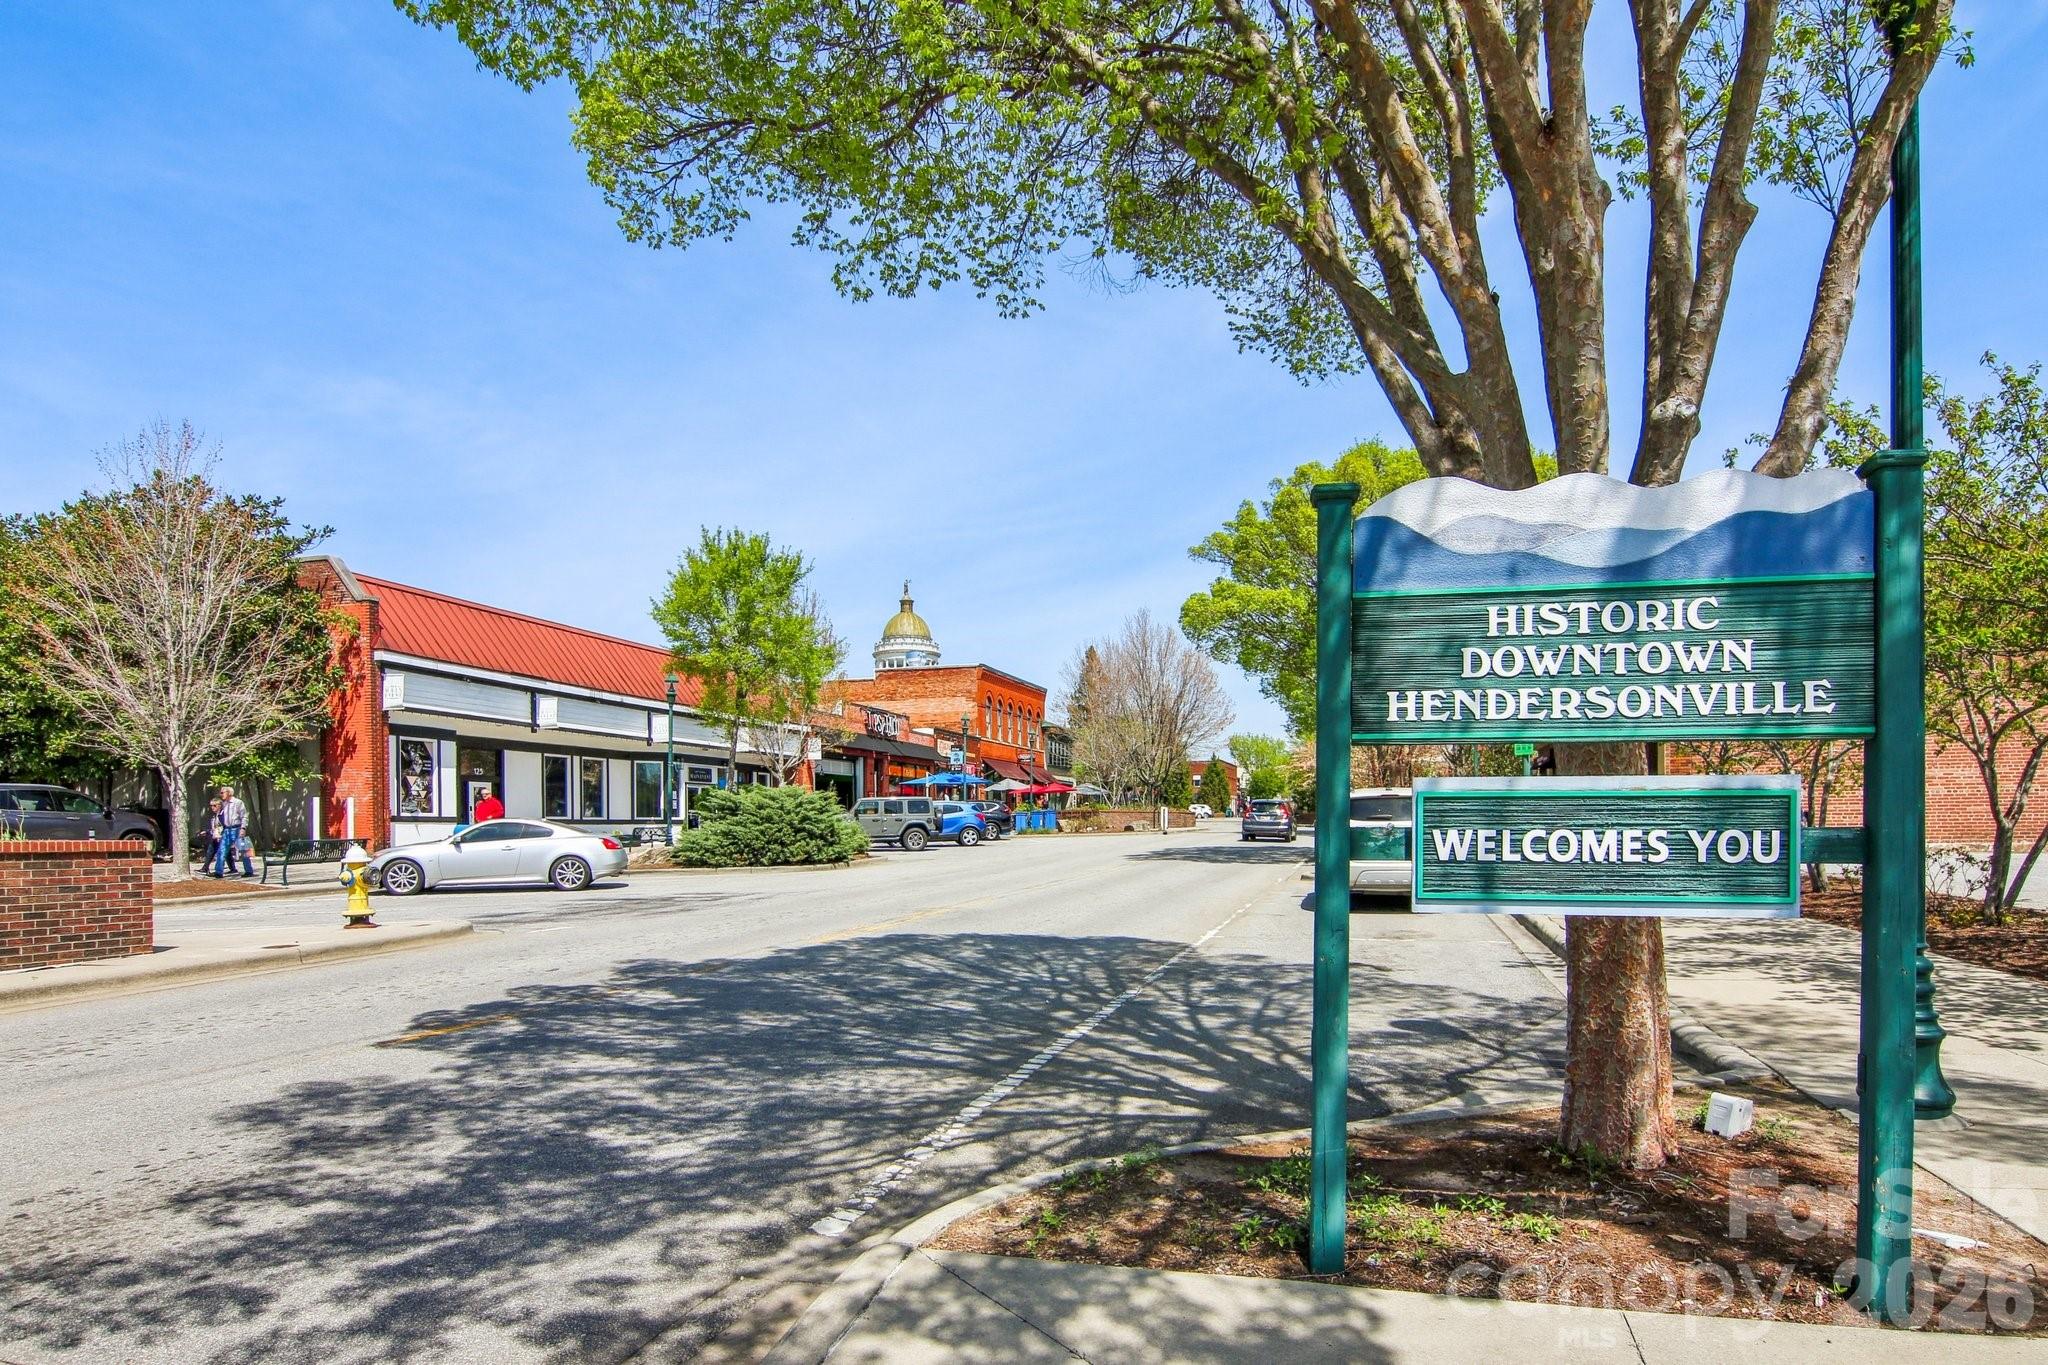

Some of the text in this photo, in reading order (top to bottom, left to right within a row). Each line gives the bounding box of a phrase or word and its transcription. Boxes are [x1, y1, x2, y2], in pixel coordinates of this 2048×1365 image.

[1486, 596, 1720, 638] HISTORIC
[1461, 638, 1754, 679] DOWNTOWN
[1386, 678, 1837, 723] HENDERSONVILLE
[1432, 828, 1782, 865] WELCOMES YOU
